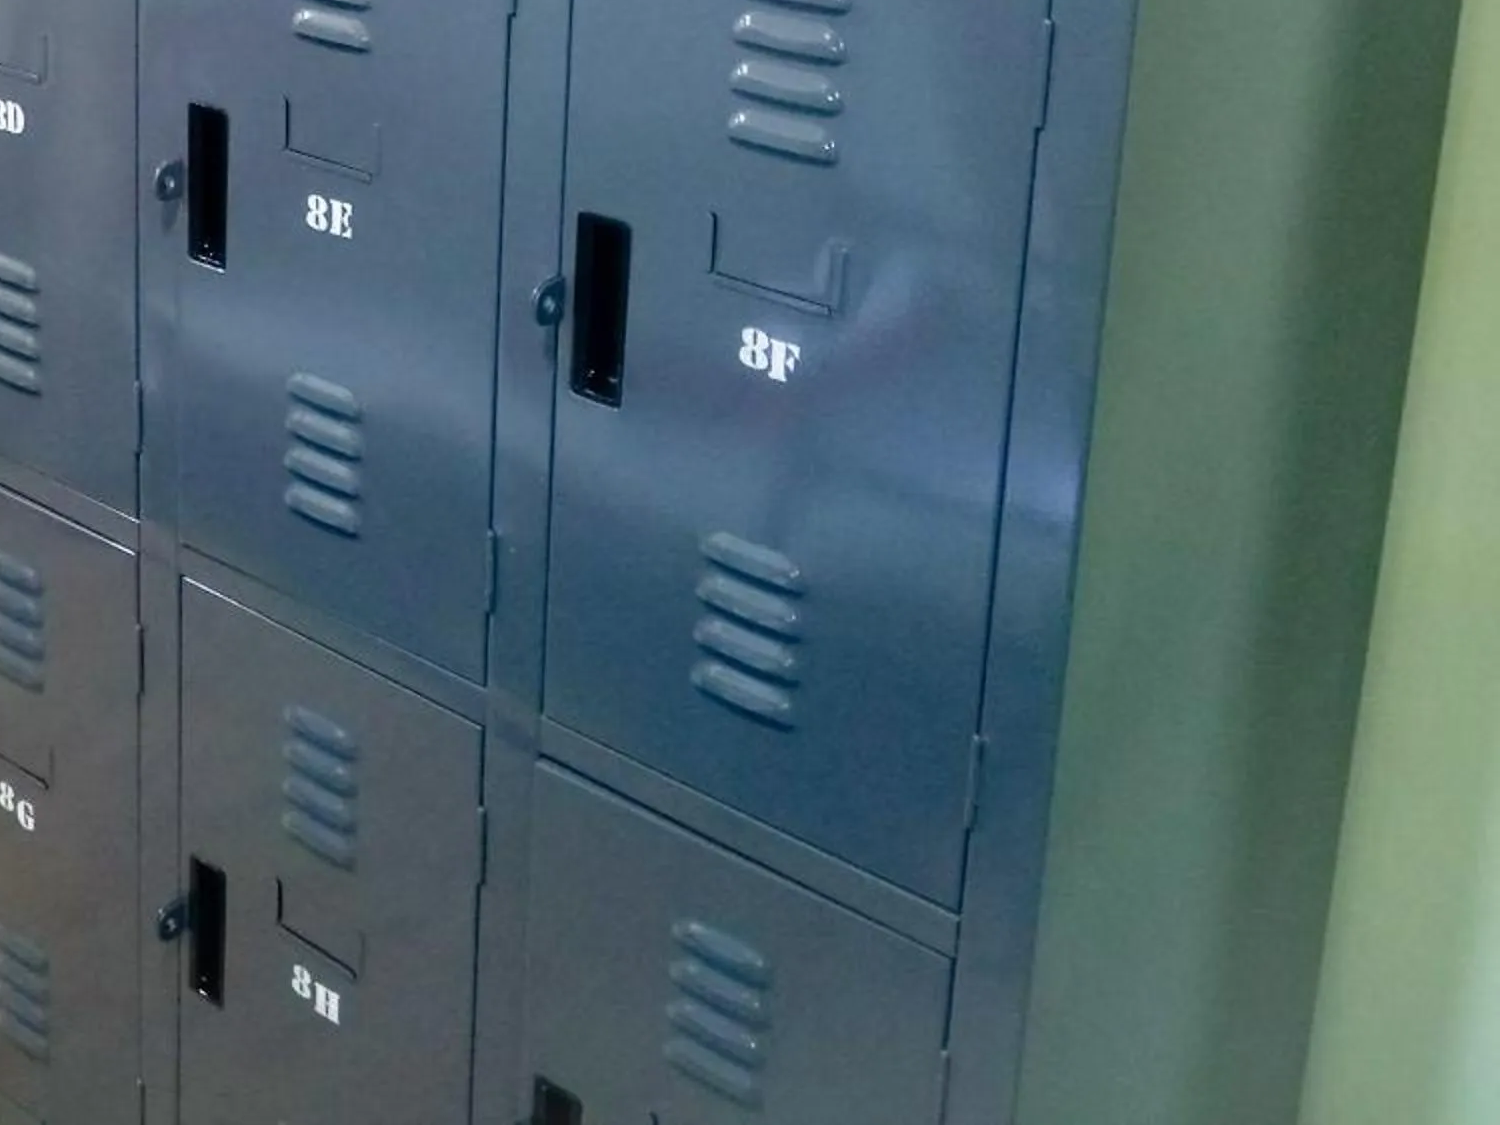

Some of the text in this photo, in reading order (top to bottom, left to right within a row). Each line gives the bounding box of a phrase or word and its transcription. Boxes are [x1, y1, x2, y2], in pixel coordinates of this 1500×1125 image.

[305, 194, 353, 239] 8E
[738, 326, 802, 382] 8F
[291, 964, 340, 1024] 8H
